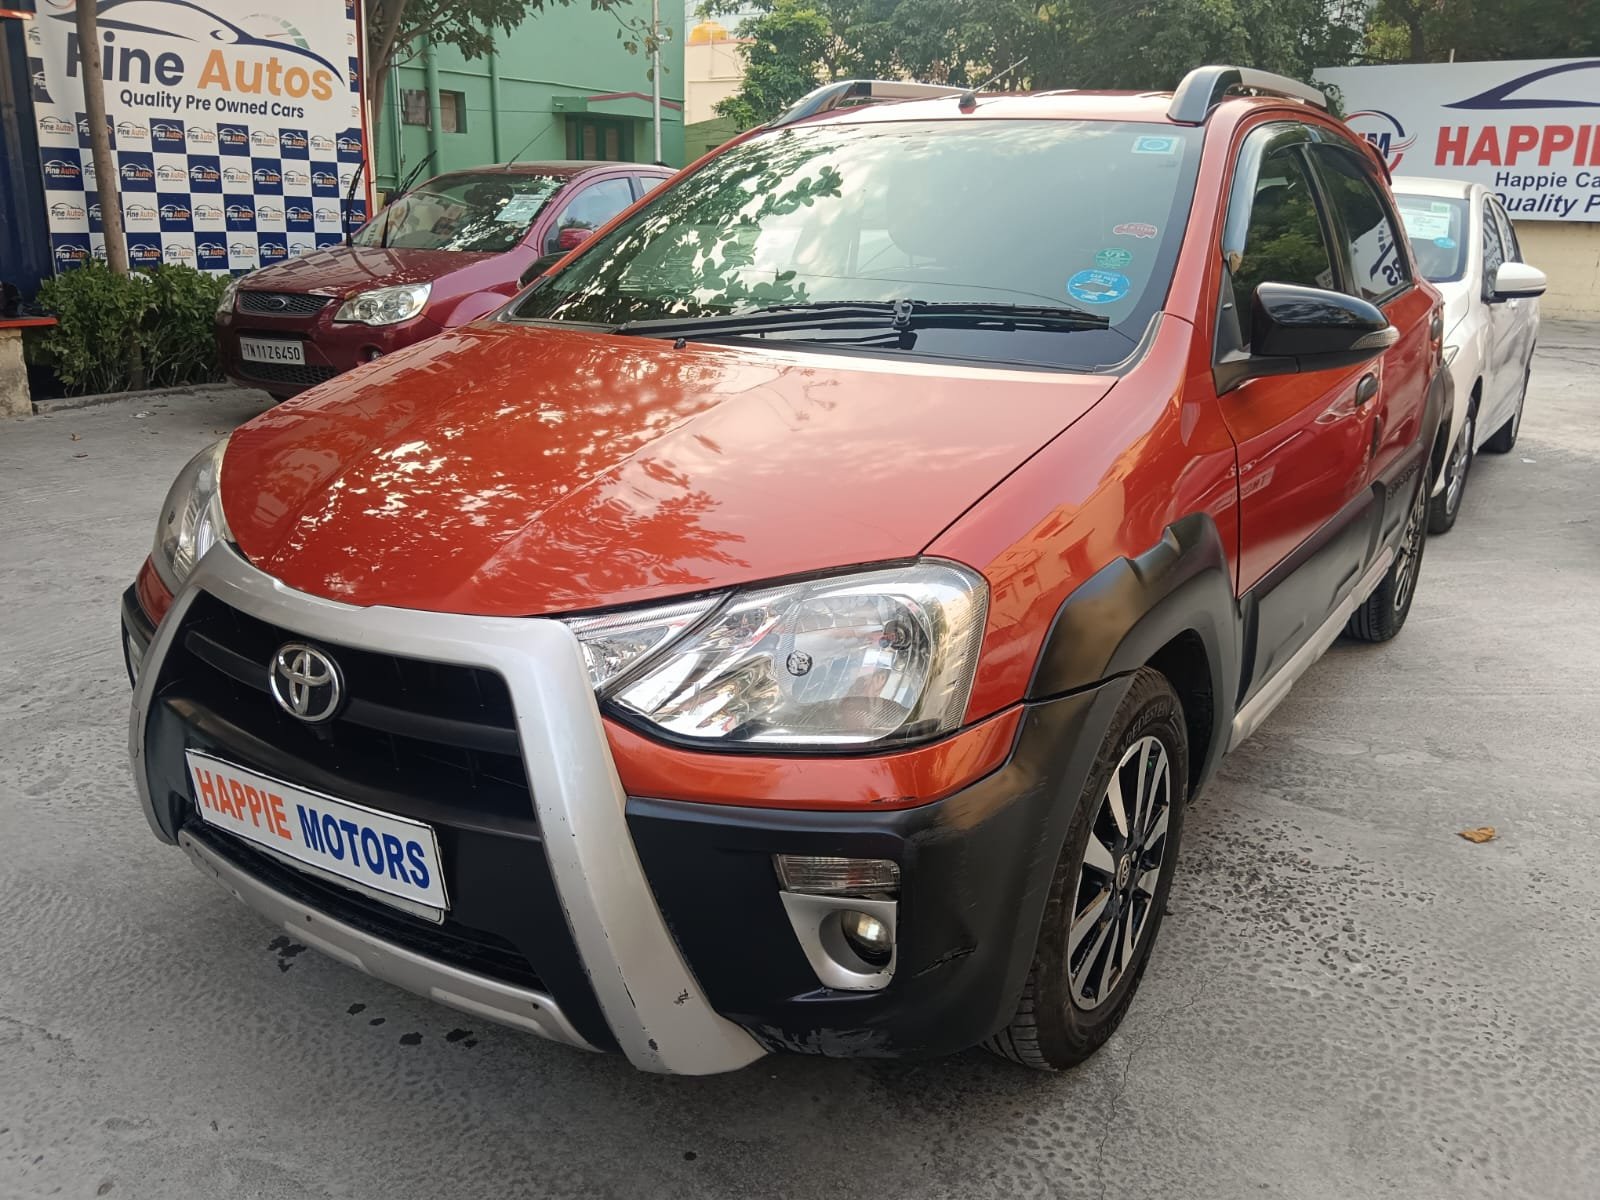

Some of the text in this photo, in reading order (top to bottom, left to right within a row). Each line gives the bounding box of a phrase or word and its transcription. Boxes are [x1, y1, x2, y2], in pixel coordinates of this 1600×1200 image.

[197, 49, 332, 101] Autos
[120, 89, 304, 118] Quality Pre Owned Cars
[1494, 172, 1568, 191] Happie
[195, 767, 430, 890] HAPPIE MOTORS
